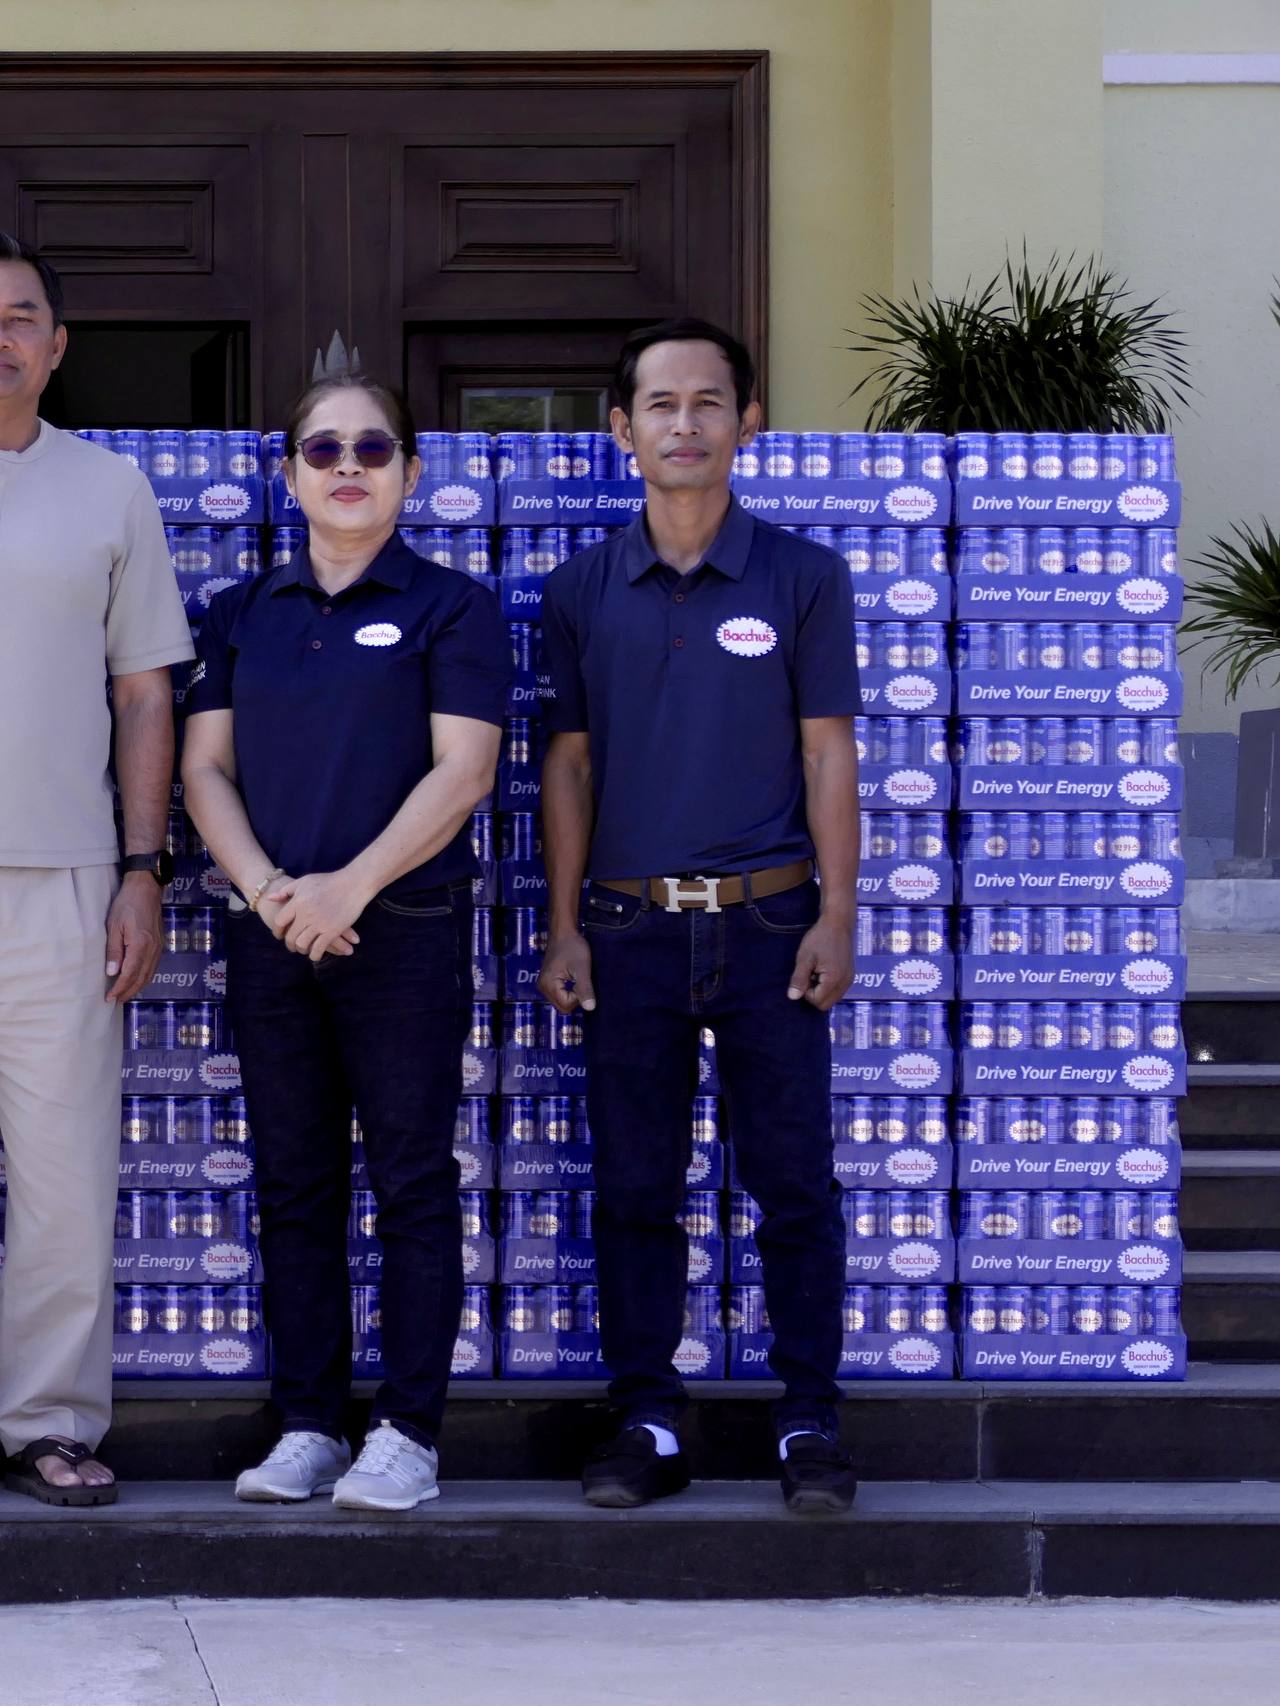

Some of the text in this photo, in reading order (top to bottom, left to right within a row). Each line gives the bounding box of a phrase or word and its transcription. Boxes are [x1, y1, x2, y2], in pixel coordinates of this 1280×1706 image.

[157, 498, 193, 511] ergy
[206, 495, 244, 506] Bacchus
[437, 496, 475, 506] Bacchus
[512, 496, 645, 512] Drive Your Energ
[740, 496, 880, 513] Drive Your Energy
[892, 496, 931, 506] Bacchus
[973, 496, 1112, 513] Drive Your Energy
[1125, 494, 1163, 505] Bacchus
[512, 590, 542, 603] Driv
[855, 592, 880, 607] rgy
[893, 590, 932, 600] Bacchus
[971, 587, 1111, 605] Drive Your Energy
[1124, 590, 1162, 600] Bacchus
[361, 631, 396, 640] Bacchus
[723, 628, 771, 642] Bacchus
[513, 688, 534, 700] Dri
[892, 685, 931, 696] Bacchus
[970, 686, 1111, 702] Drive Your Energy
[1124, 686, 1162, 696] Bacchus
[510, 782, 540, 794] Driv
[892, 780, 930, 792] Bacchus
[972, 780, 1113, 797] Drive Your Energy
[1126, 781, 1165, 792] Bacchus
[513, 876, 546, 888] Driv
[856, 877, 883, 891] rgy
[896, 876, 934, 887] Bacchus
[975, 873, 1114, 890] Drive Your Energy
[1128, 876, 1167, 888] Bacchus
[152, 974, 197, 986] nergy
[898, 969, 935, 980] Bacchus
[975, 970, 1116, 986] Drive Your Energy
[1129, 970, 1167, 982] Bacchus
[137, 1065, 193, 1081] Energy
[206, 1064, 240, 1074] Bacchu
[512, 1064, 586, 1077] Drive You
[896, 1064, 934, 1075] Bacchus
[976, 1066, 1117, 1082] Drive Your Energy
[1130, 1064, 1168, 1076] Bacchus
[139, 1160, 196, 1176] Energy
[209, 1158, 248, 1169] Bacchus
[514, 1161, 553, 1174] Drive
[834, 1161, 880, 1176] nergy
[893, 1160, 931, 1170] Bacchus
[970, 1159, 1111, 1175] Drive Your Energy
[1124, 1160, 1162, 1171] Bacchus
[138, 1254, 195, 1270] Energy
[208, 1252, 246, 1263] Bacchus
[514, 1255, 595, 1268] Drive Your
[847, 1256, 882, 1269] ergy
[896, 1254, 934, 1264] Bacchus
[1125, 1253, 1163, 1264] Bacchus
[972, 1256, 1112, 1272] Drive Your Energy
[138, 1350, 194, 1366] Energy
[207, 1348, 245, 1359] Bacchus
[513, 1349, 593, 1362] Drive Your
[896, 1350, 934, 1361] Bacchus
[1129, 1350, 1168, 1361] Bacchus
[976, 1352, 1116, 1368] Drive Your Energy
